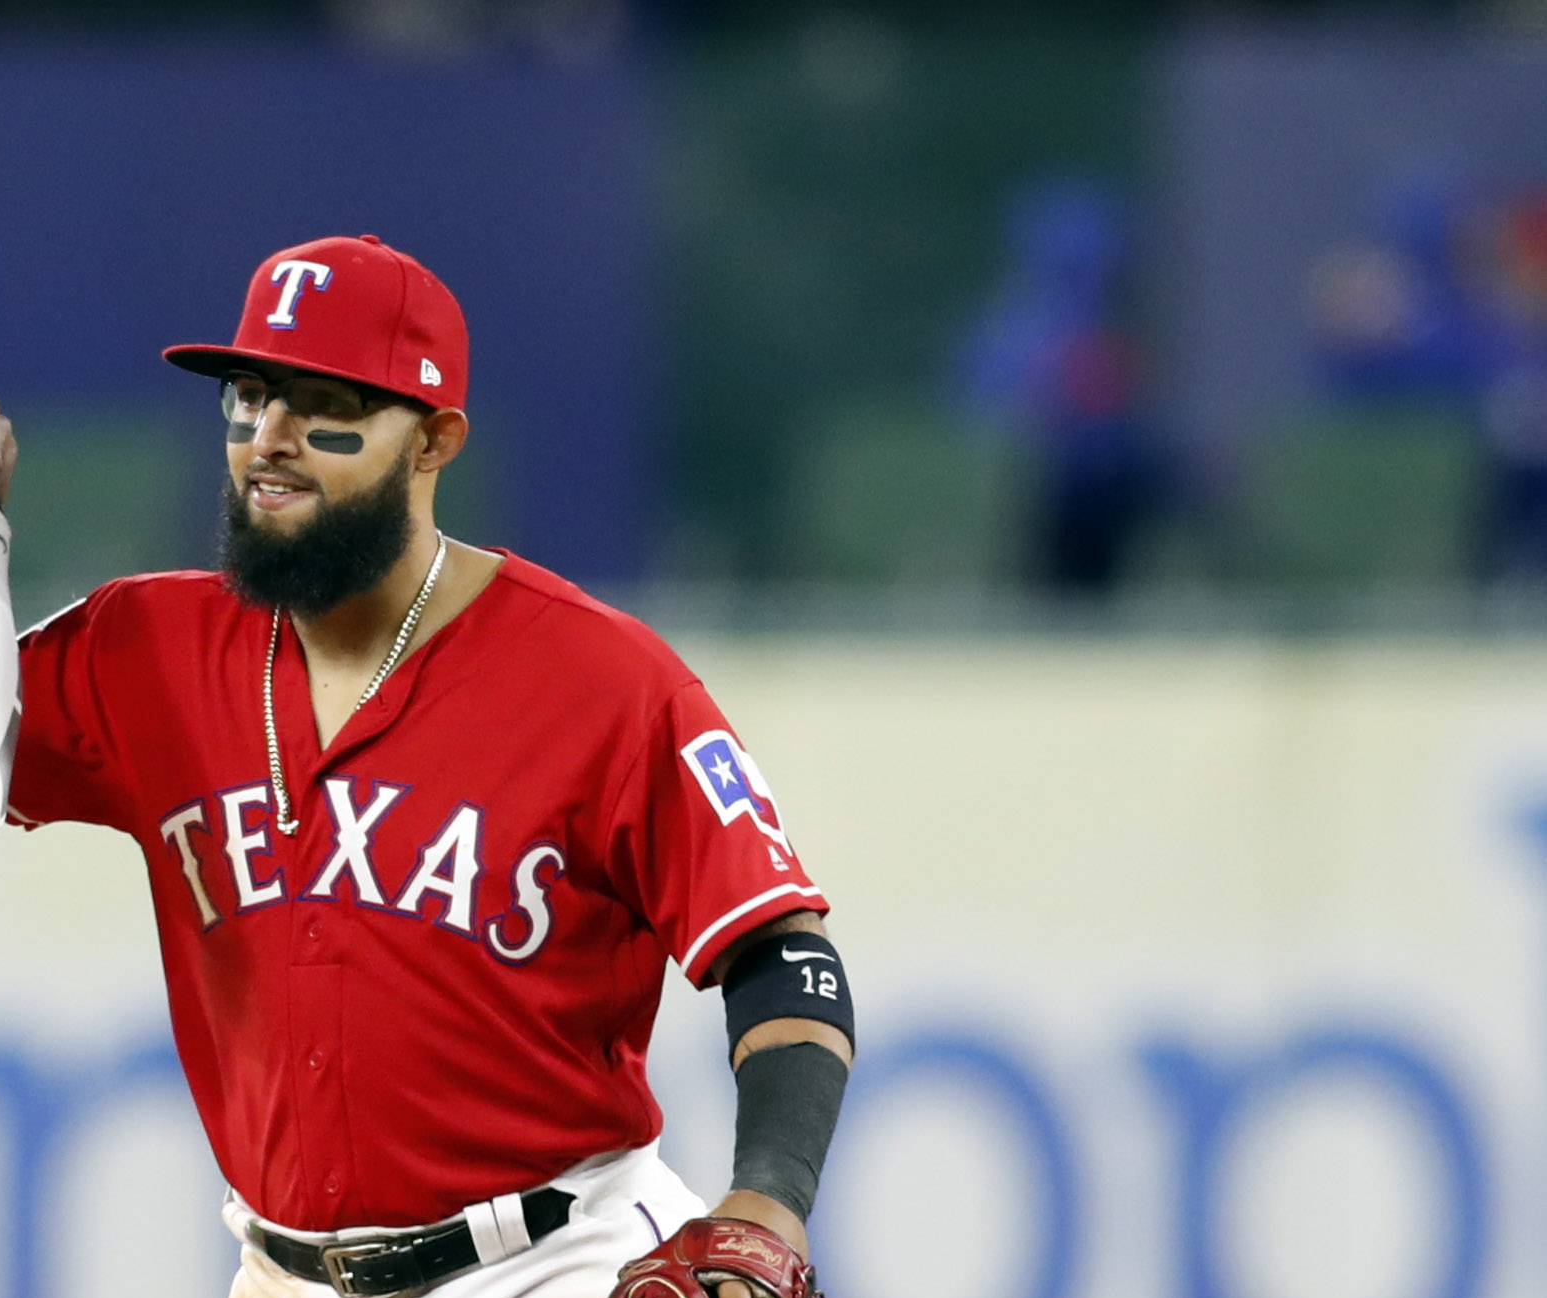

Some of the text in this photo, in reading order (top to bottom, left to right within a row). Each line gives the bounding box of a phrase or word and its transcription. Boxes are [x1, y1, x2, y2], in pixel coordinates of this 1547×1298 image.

[267, 259, 334, 330] T
[159, 772, 567, 968] TEXAS
[800, 965, 839, 1001] 12
